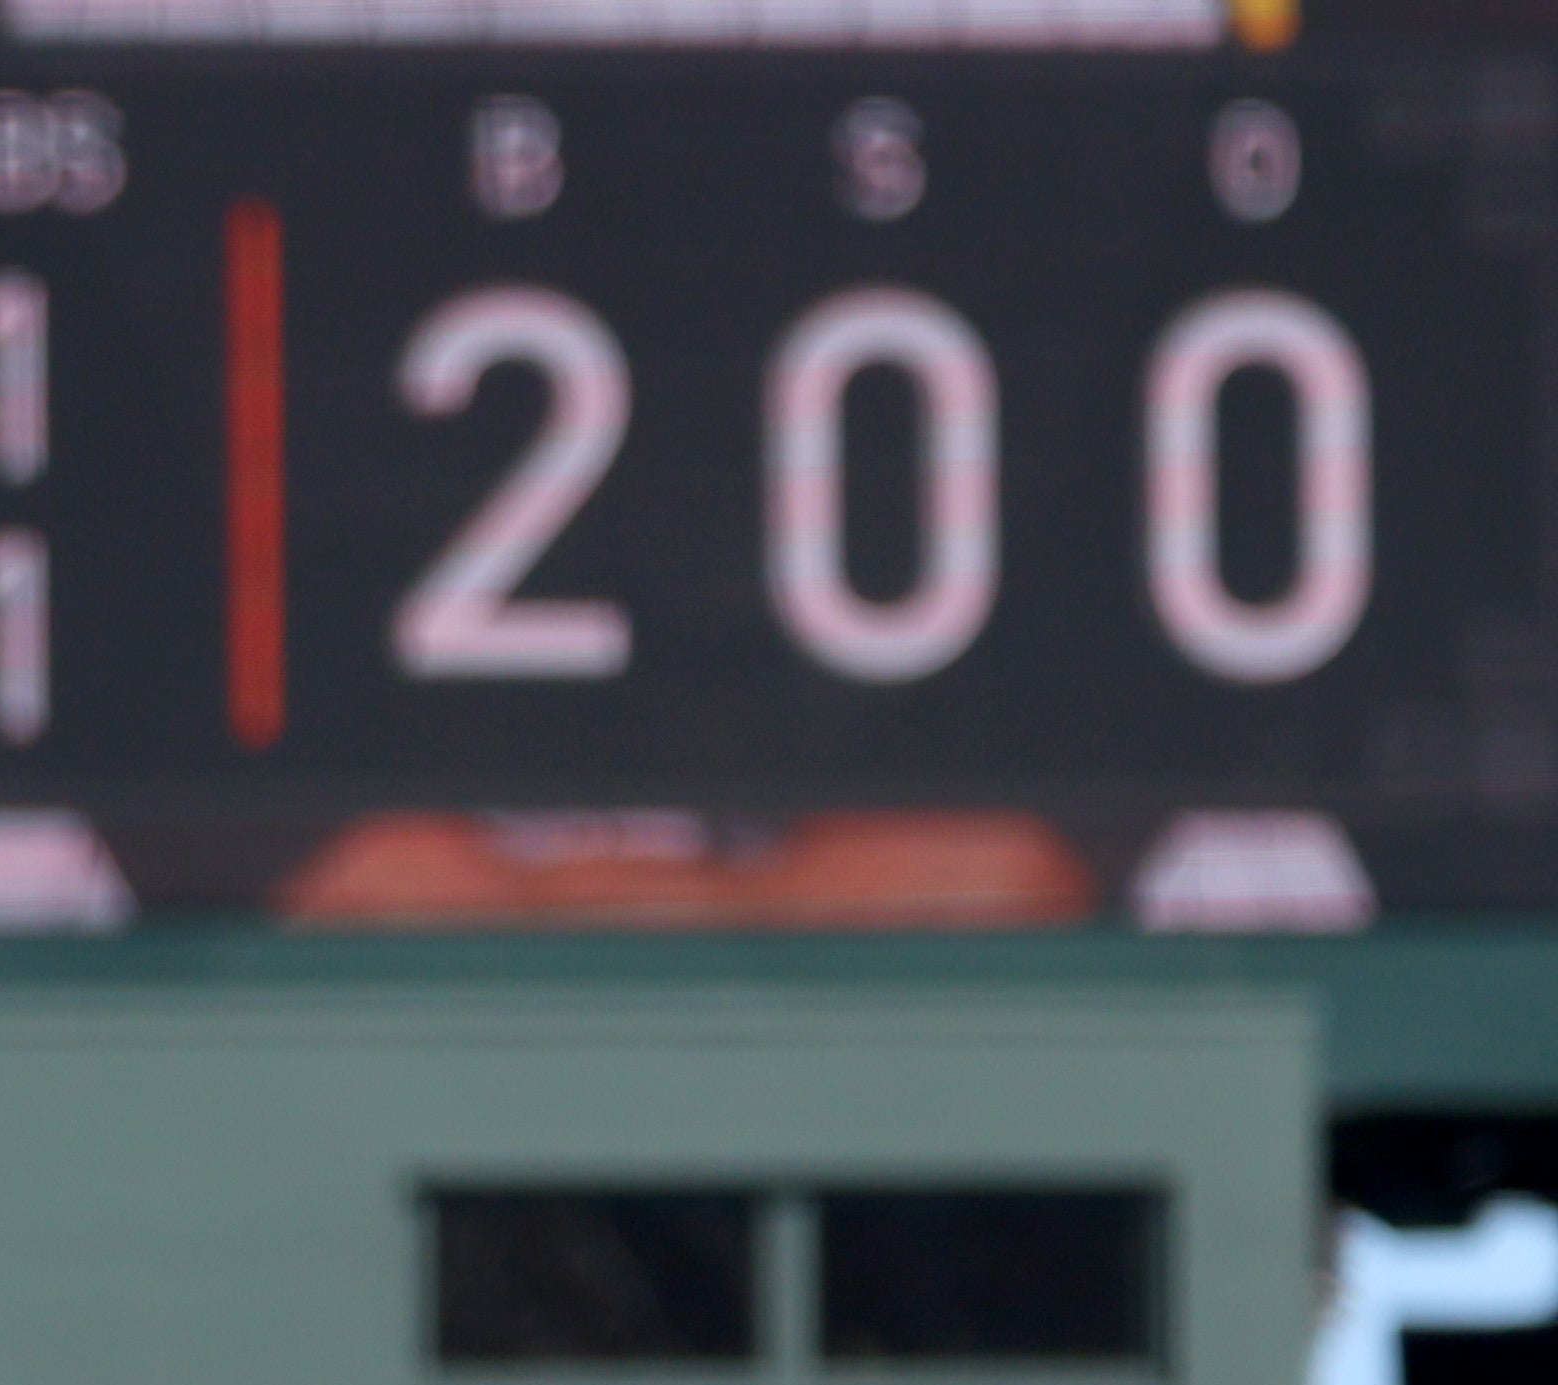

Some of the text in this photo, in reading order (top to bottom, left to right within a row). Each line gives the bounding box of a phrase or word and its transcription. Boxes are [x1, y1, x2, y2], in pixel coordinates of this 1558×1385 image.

[466, 98, 564, 218] B
[832, 98, 926, 218] S
[399, 292, 1368, 677] 2 0 0
